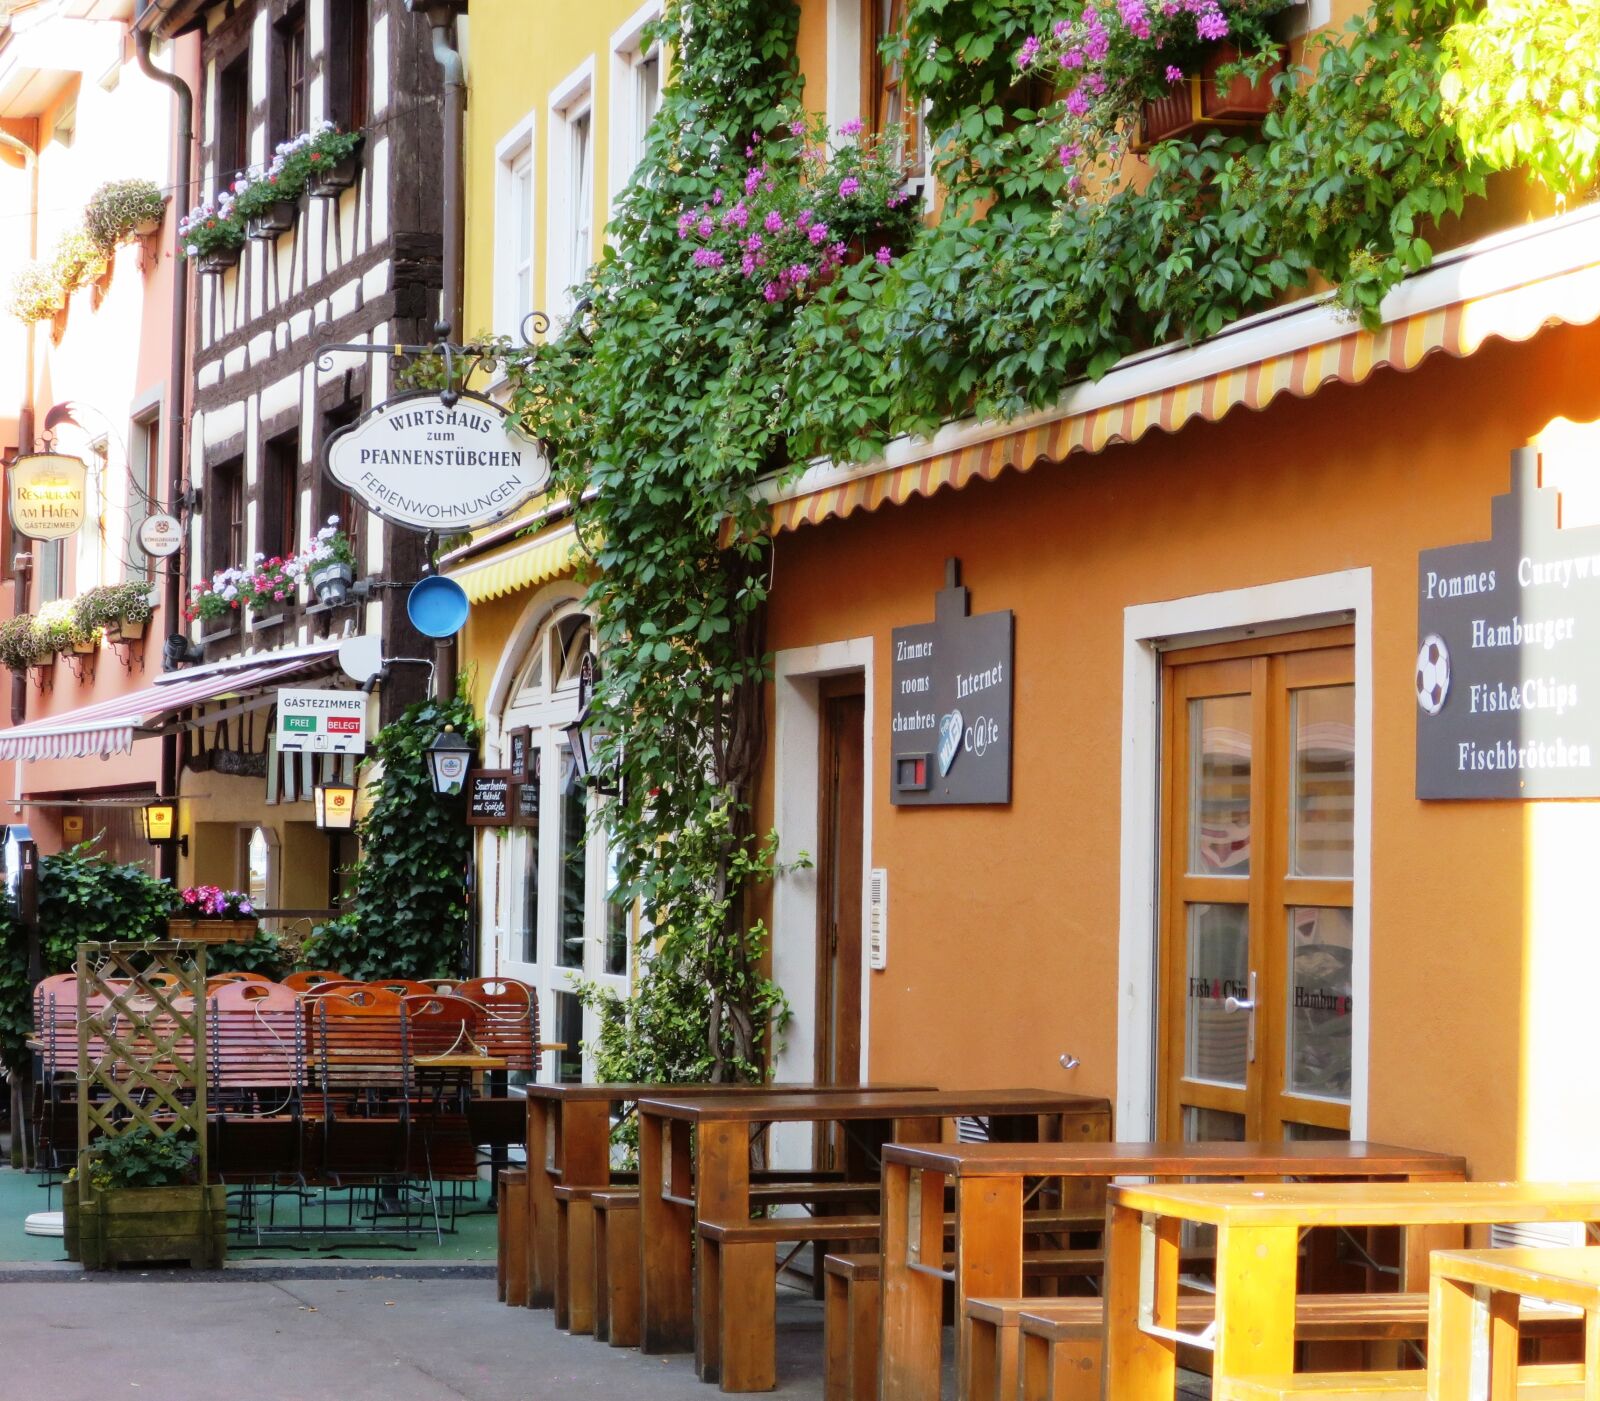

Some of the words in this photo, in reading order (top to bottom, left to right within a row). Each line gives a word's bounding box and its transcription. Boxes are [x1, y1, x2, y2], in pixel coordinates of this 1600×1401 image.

[389, 410, 492, 433] WIRTSHAUS
[427, 432, 455, 441] zum
[360, 446, 521, 467] PFANNENSTÜBCHEN
[360, 471, 522, 518] FERIENWOHNUNGEN
[1427, 570, 1496, 599] Pommes
[1472, 616, 1575, 650] Hamburger
[897, 640, 932, 661] Zimmer
[901, 676, 930, 694] rooms
[956, 661, 1003, 699] Internet
[284, 696, 361, 709] GÄSTEZIMMER
[1470, 679, 1578, 715] Fish&Chips
[290, 719, 309, 728] FREI
[328, 721, 360, 730] BELEGT
[893, 710, 935, 732] chambres
[1458, 737, 1591, 771] Fischbrötchen
[1189, 977, 1210, 998] Fish
